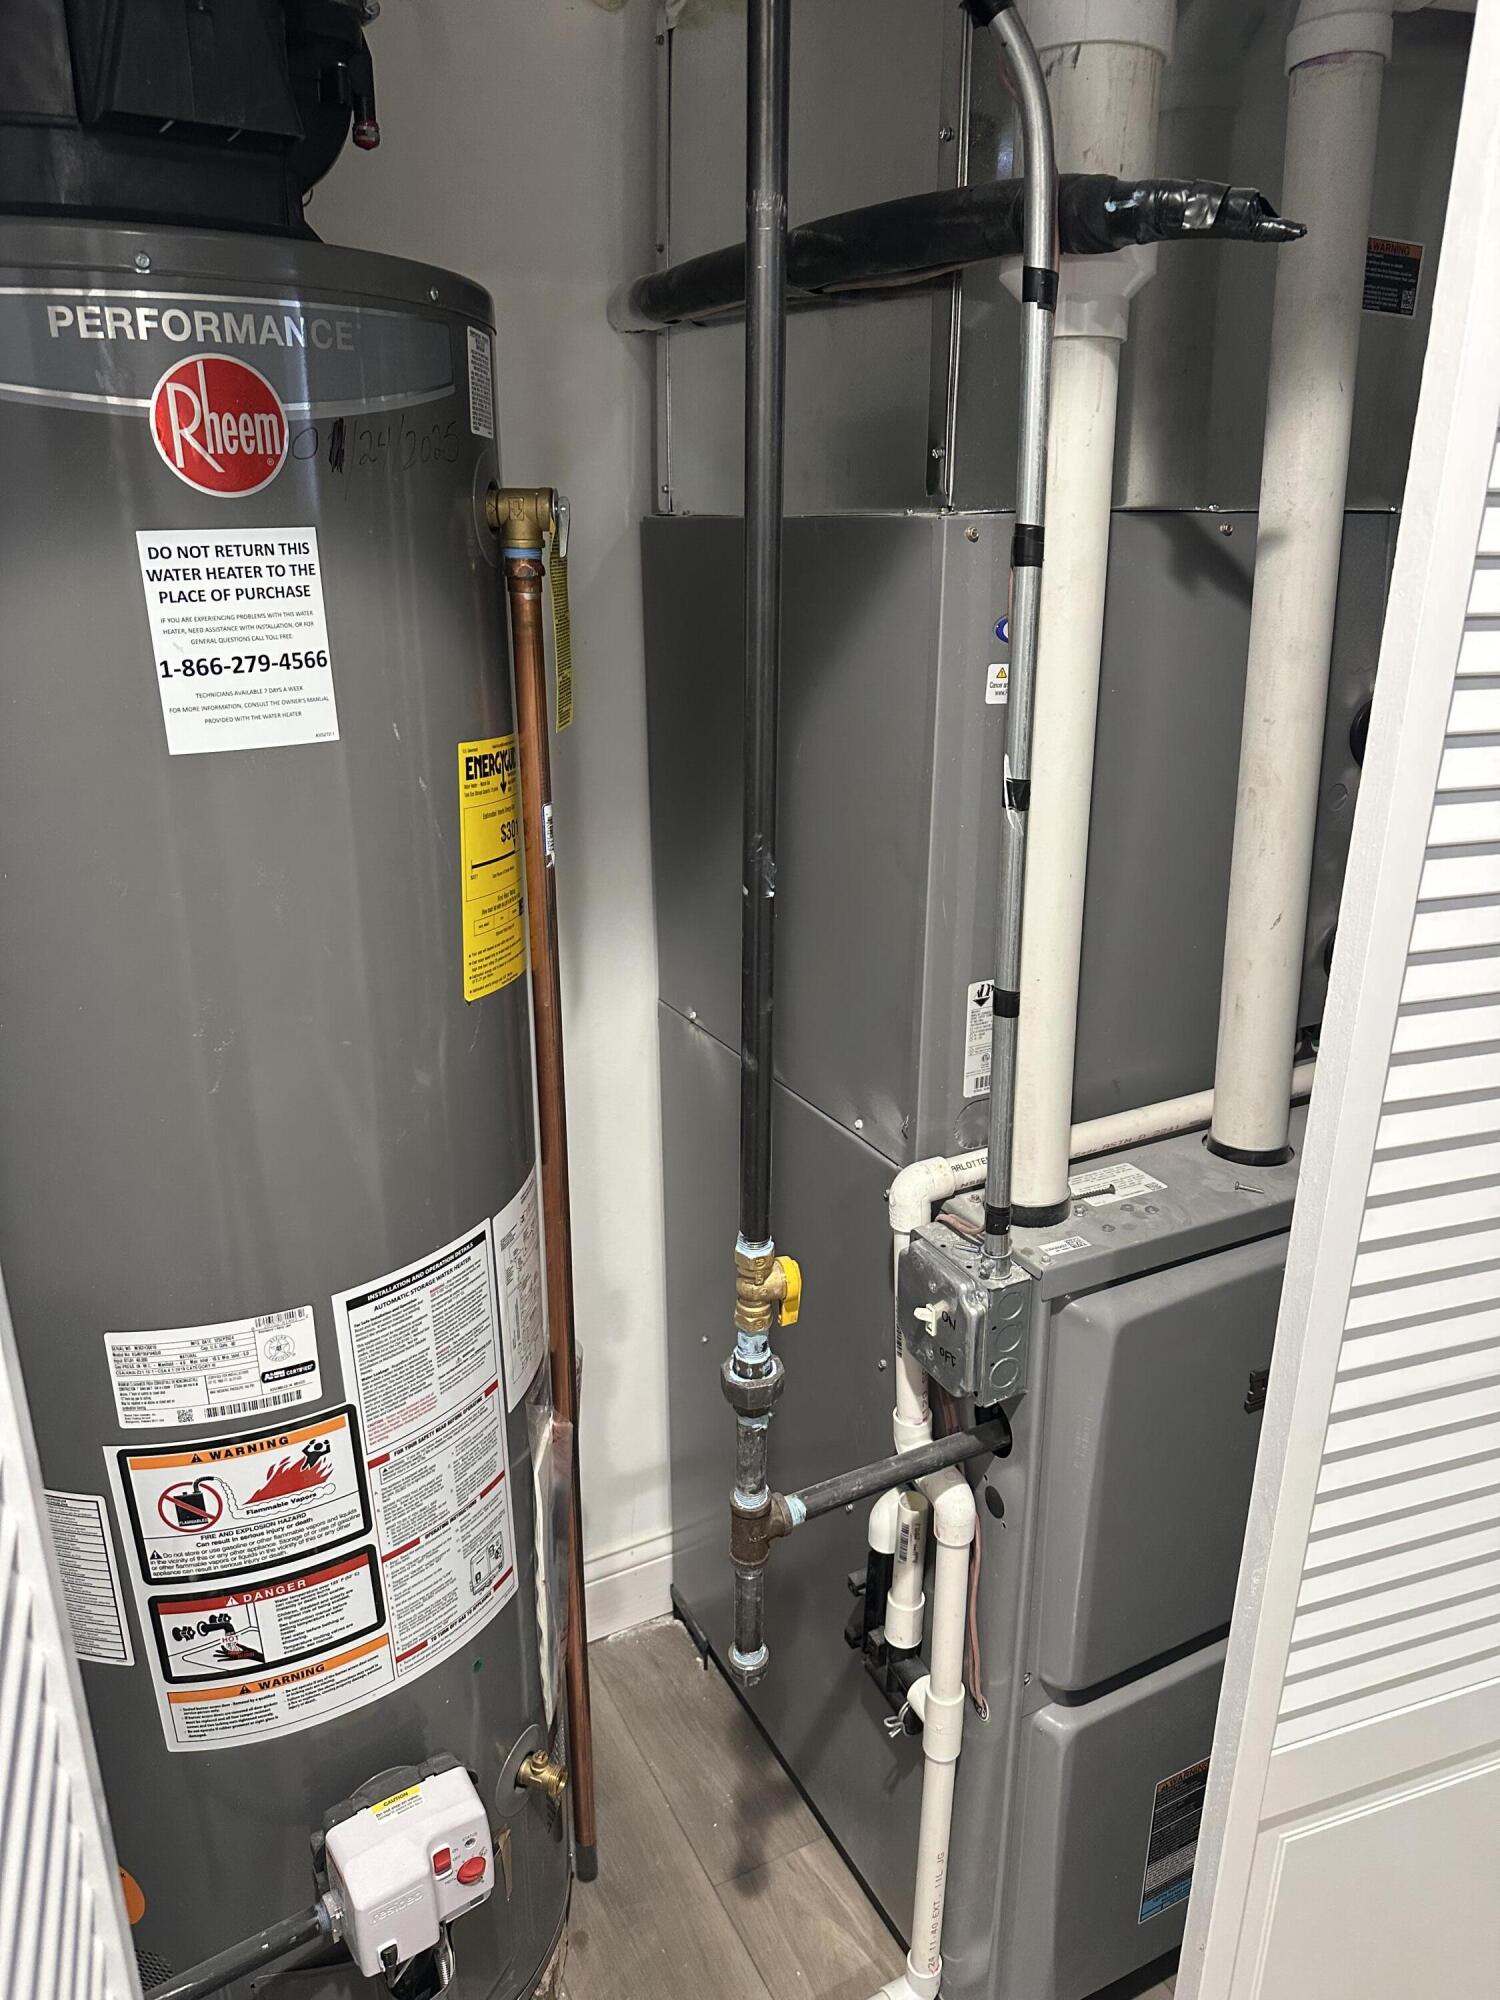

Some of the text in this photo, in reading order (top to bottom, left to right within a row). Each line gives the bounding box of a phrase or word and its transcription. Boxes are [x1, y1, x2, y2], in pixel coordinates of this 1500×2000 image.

[47, 306, 355, 352] PERFORMANCE
[166, 361, 281, 472] Rheem
[148, 542, 310, 559] DO NOT RETURN THIS
[146, 563, 316, 582] WATER HEATER TO THE
[159, 585, 311, 604] PLACE OF PURCHASE
[194, 614, 236, 622] EXPERIENCING
[236, 612, 266, 620] PROBLEMS
[163, 627, 187, 635] HEATER,
[205, 625, 238, 633] ASSISTANCE
[218, 636, 251, 644] QUESTIONS
[159, 650, 328, 679] 1-866-279-4566
[196, 691, 234, 699] TECHNICIANS
[234, 689, 263, 697] AVAILABLE
[201, 703, 243, 712] INFORMATION,
[244, 701, 269, 709] CONSULT
[204, 717, 234, 725] PROVIDED
[282, 711, 302, 719] HEATER
[367, 1242, 474, 1301] INSTALLATION AND OPERATION DETAILS
[374, 1256, 472, 1312] AUTOMATIC STORAGE WATER HEATER
[942, 1311, 956, 1330] ON
[209, 1436, 289, 1460] WARNING
[246, 1492, 317, 1515] Flammable Vapors
[222, 1543, 247, 1552] gasoline
[256, 1536, 273, 1545] other
[273, 1527, 305, 1540] flammable
[306, 1519, 326, 1530] vapors
[327, 1515, 338, 1523] and
[339, 1508, 357, 1520] liquids
[236, 1522, 276, 1534] EXPLOSION
[278, 1513, 307, 1524] HAZARD
[279, 1534, 303, 1545] Storage
[337, 1513, 361, 1527] gasoline
[176, 1561, 207, 1569] flammable
[238, 1552, 258, 1561] liquids
[277, 1541, 297, 1551] vicinity
[305, 1535, 317, 1543] this
[336, 1523, 351, 1532] other
[211, 1538, 230, 1546] result
[240, 1531, 265, 1540] serious
[266, 1526, 285, 1536] injury
[244, 1556, 260, 1566] injury
[243, 1579, 307, 1602] DANGER
[222, 1634, 239, 1643] HOT
[258, 1664, 325, 1690] WARNING
[383, 1792, 409, 1806] CAUTION
